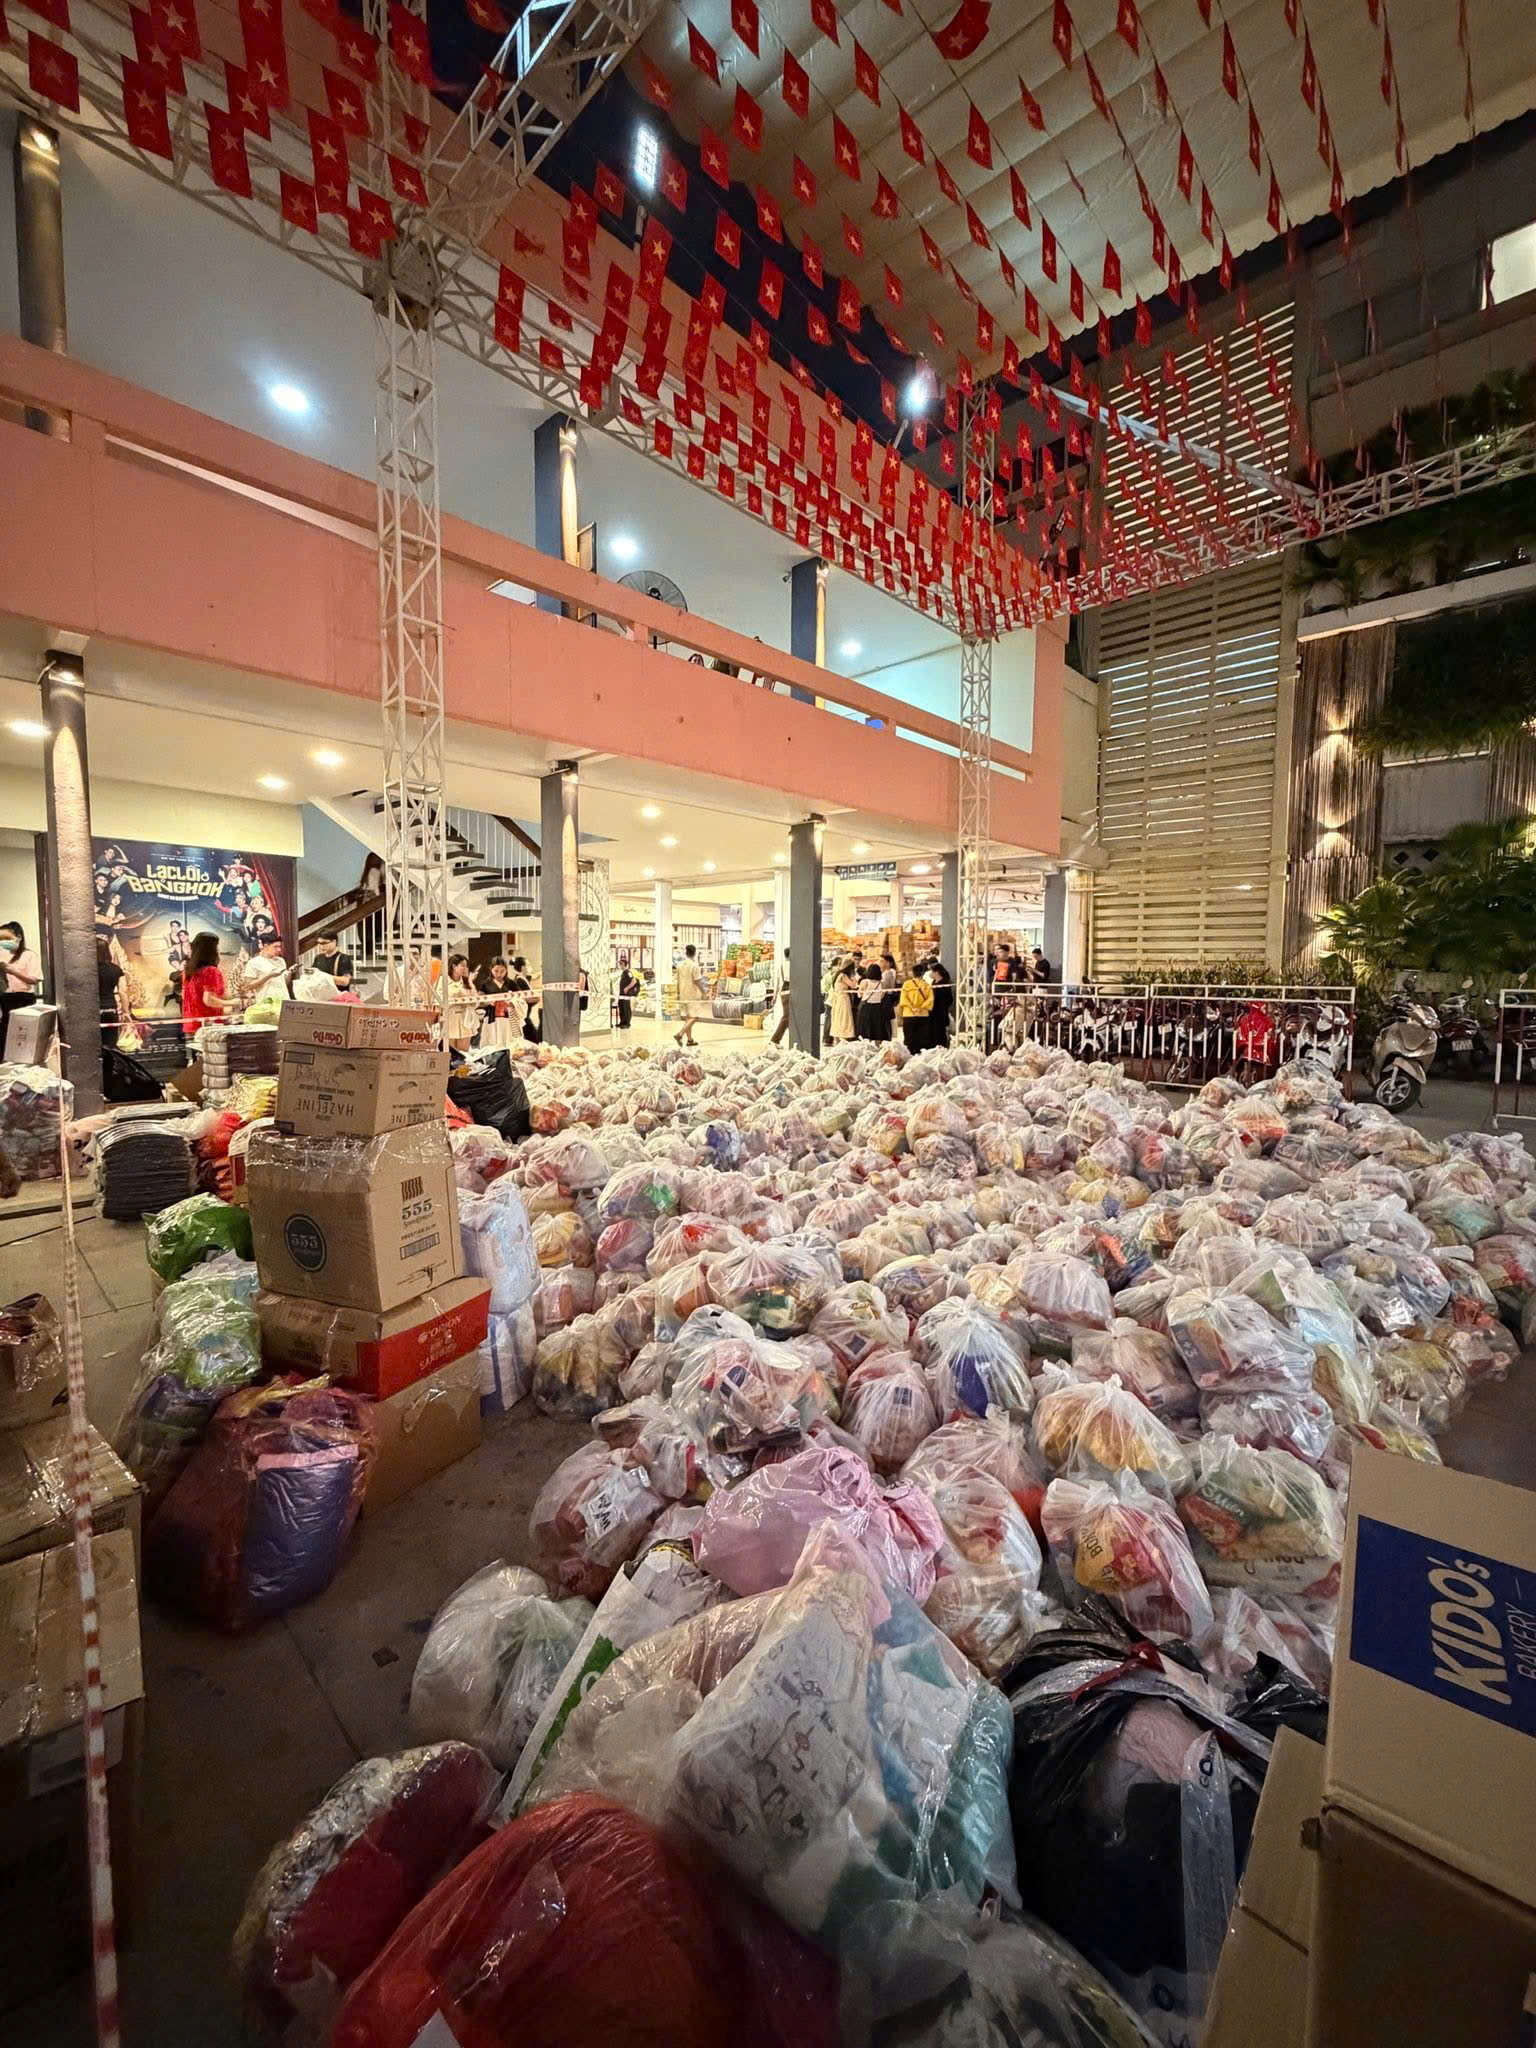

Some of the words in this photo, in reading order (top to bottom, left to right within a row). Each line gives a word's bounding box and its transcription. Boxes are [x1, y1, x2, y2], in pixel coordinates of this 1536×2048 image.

[296, 1098, 354, 1117] HAZELINE
[401, 1198, 433, 1220] 555
[290, 1234, 318, 1249] 555
